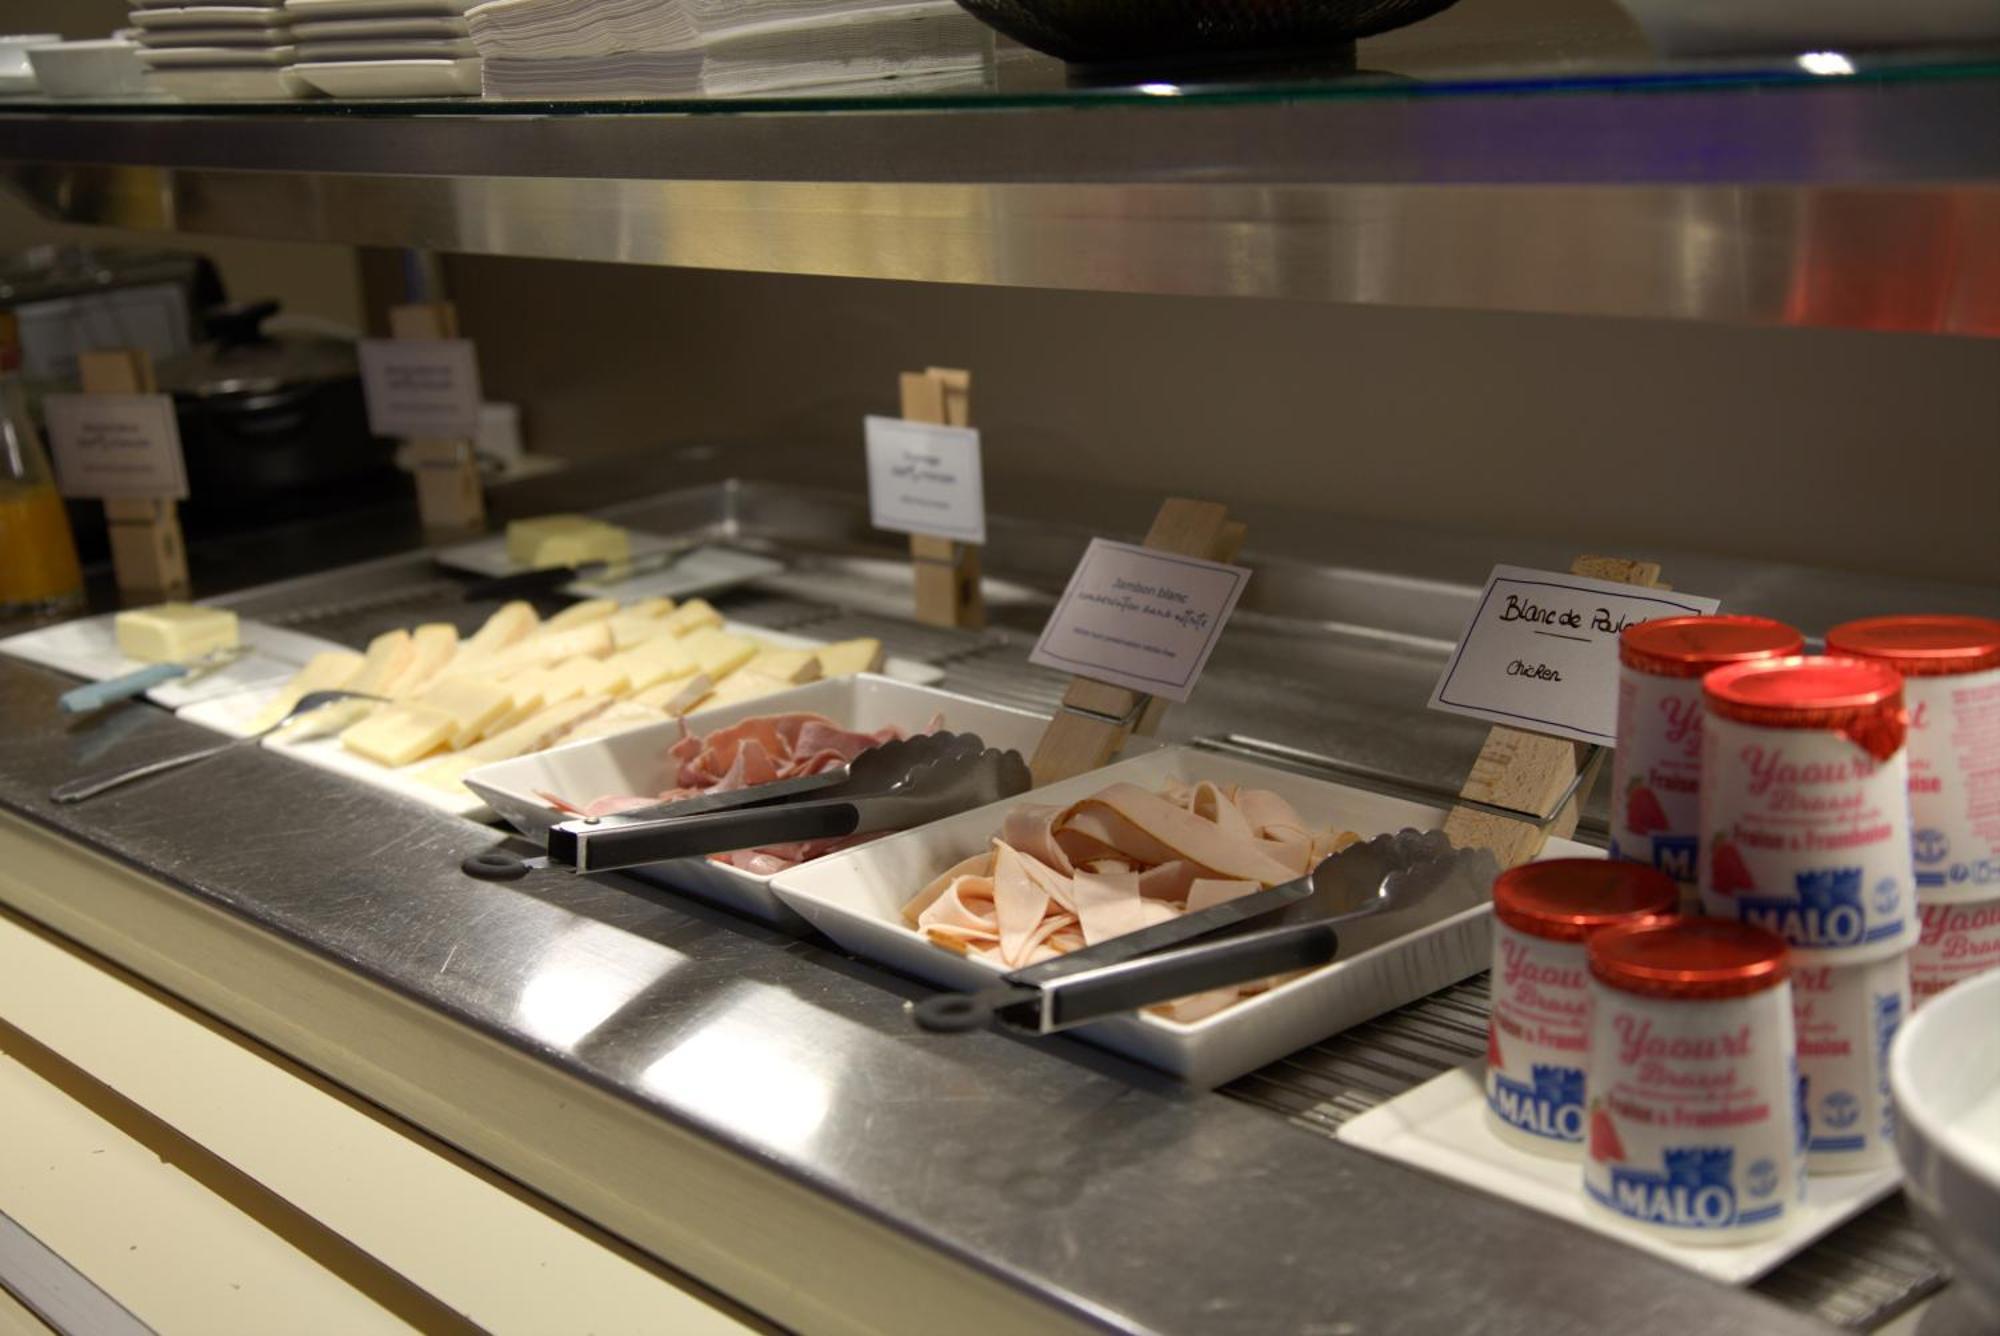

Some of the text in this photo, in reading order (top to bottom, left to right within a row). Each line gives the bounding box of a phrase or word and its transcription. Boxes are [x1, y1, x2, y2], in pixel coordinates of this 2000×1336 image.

[1158, 585, 1190, 604] blanc
[1500, 595, 1648, 634] Blanc de Poul
[1507, 660, 1563, 682] Chicken
[1502, 937, 1586, 989] Yaou
[1612, 1014, 1754, 1066] Yaourt
[1499, 1086, 1585, 1139] MALO
[1616, 1178, 1733, 1226] MALO
